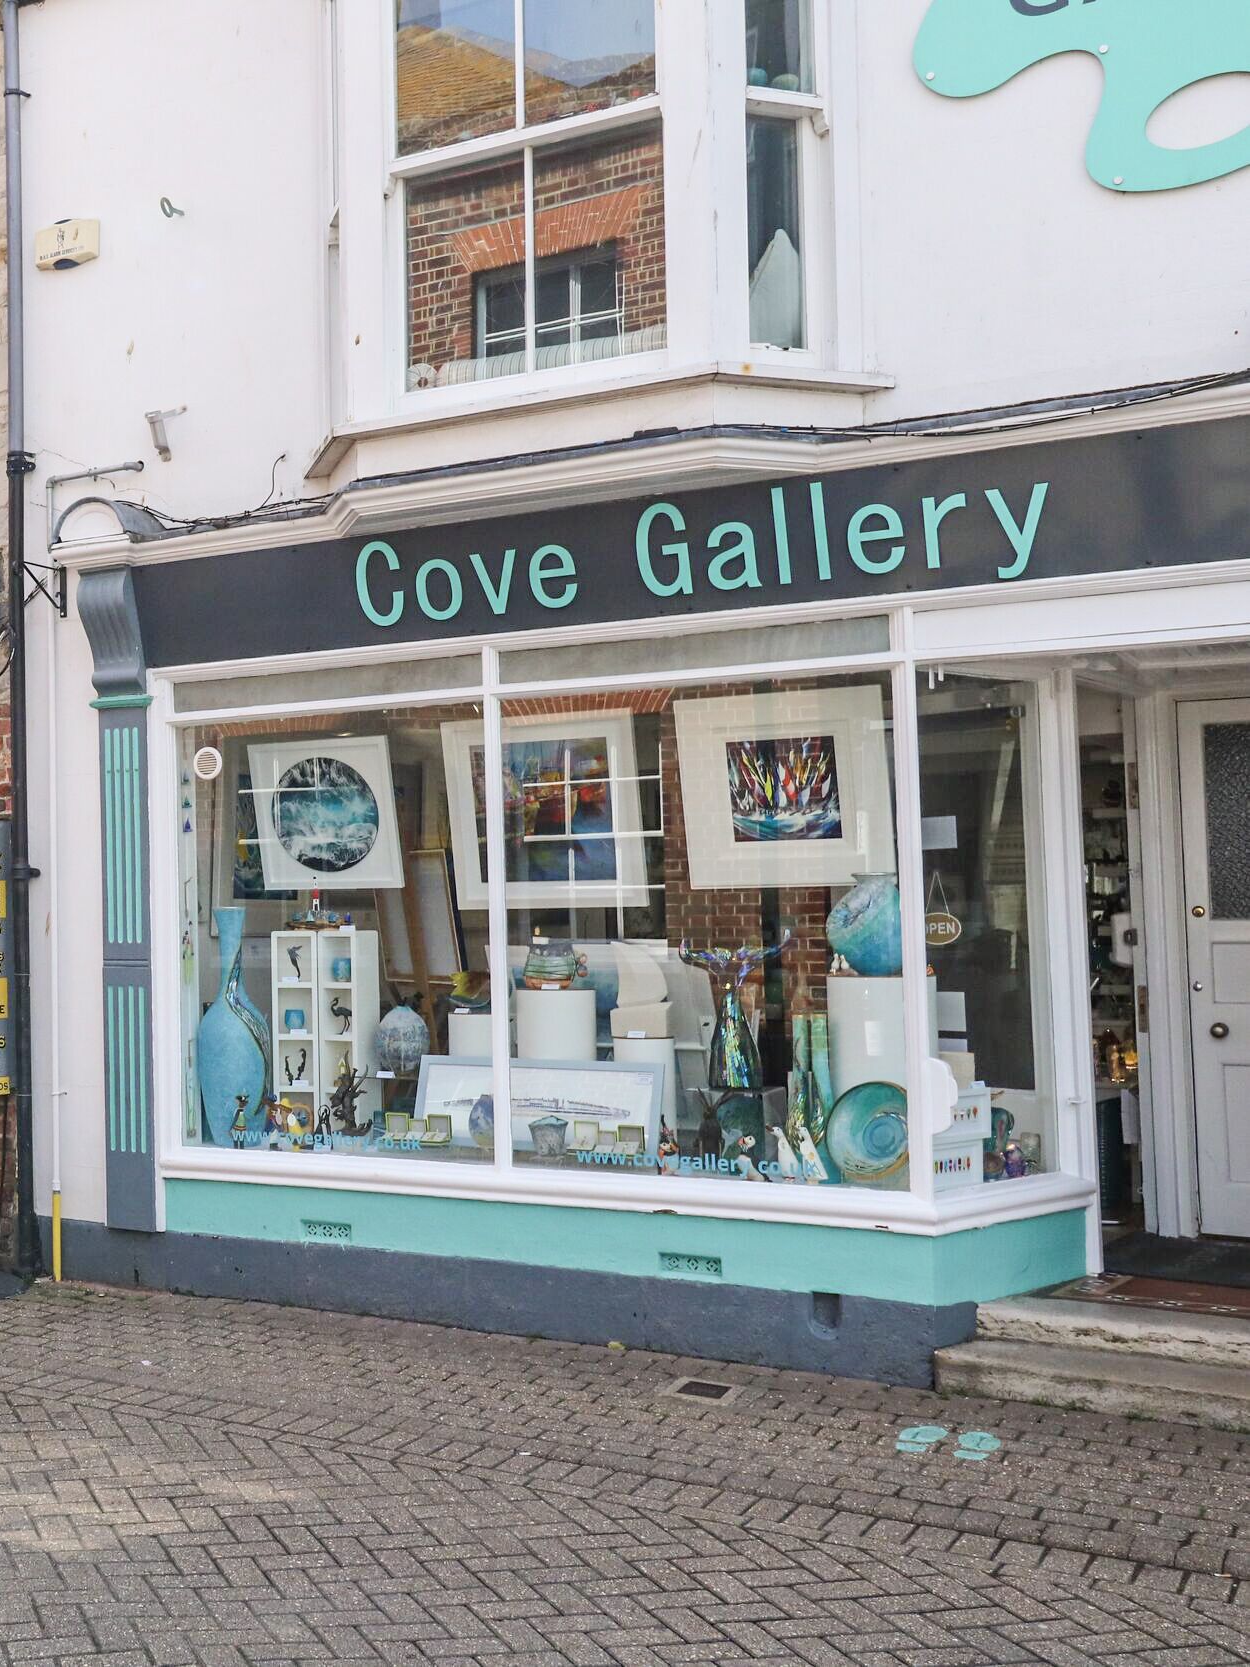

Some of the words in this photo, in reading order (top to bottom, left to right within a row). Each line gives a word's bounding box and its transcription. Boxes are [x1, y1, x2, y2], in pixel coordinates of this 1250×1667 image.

[354, 539, 579, 627] Cove
[634, 481, 1050, 598] Gallery
[926, 922, 956, 935] PEN
